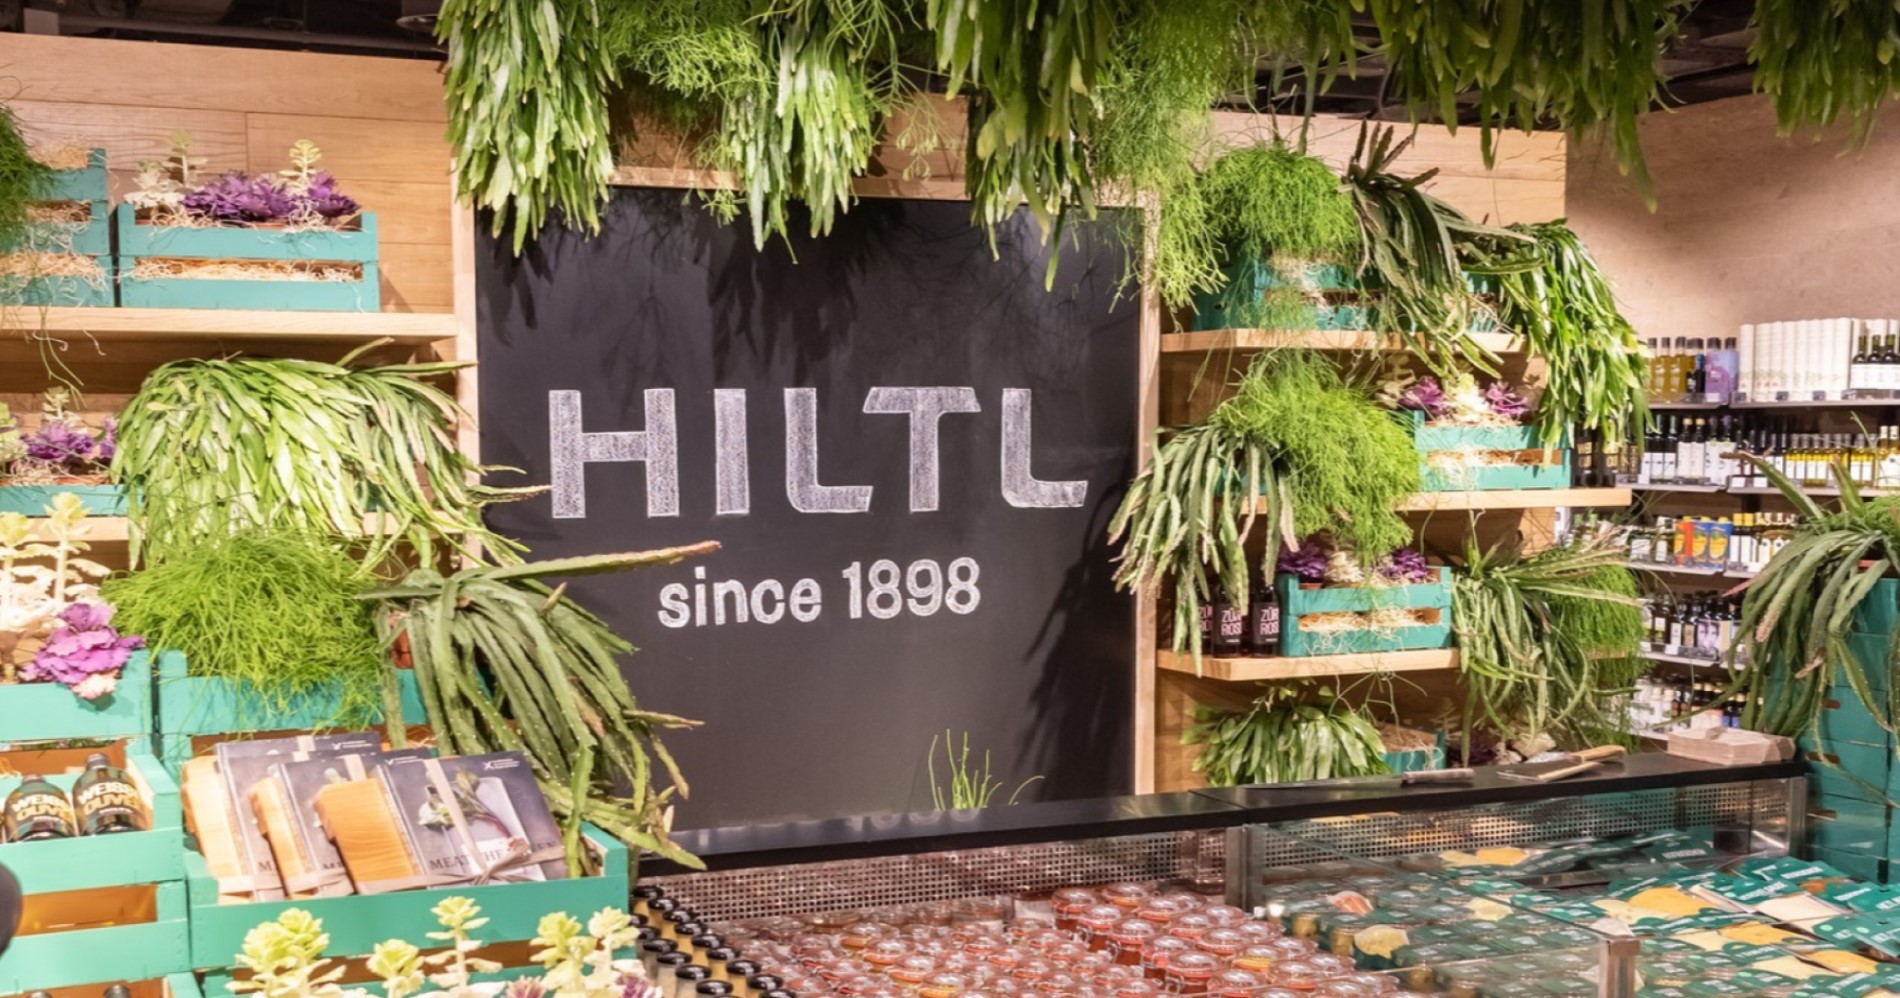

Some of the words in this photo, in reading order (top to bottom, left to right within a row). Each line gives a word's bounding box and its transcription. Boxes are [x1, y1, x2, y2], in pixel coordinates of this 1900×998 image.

[548, 386, 1088, 518] HILTL
[658, 566, 821, 628] since
[842, 556, 981, 619] 1898
[430, 855, 469, 871] MEAT
